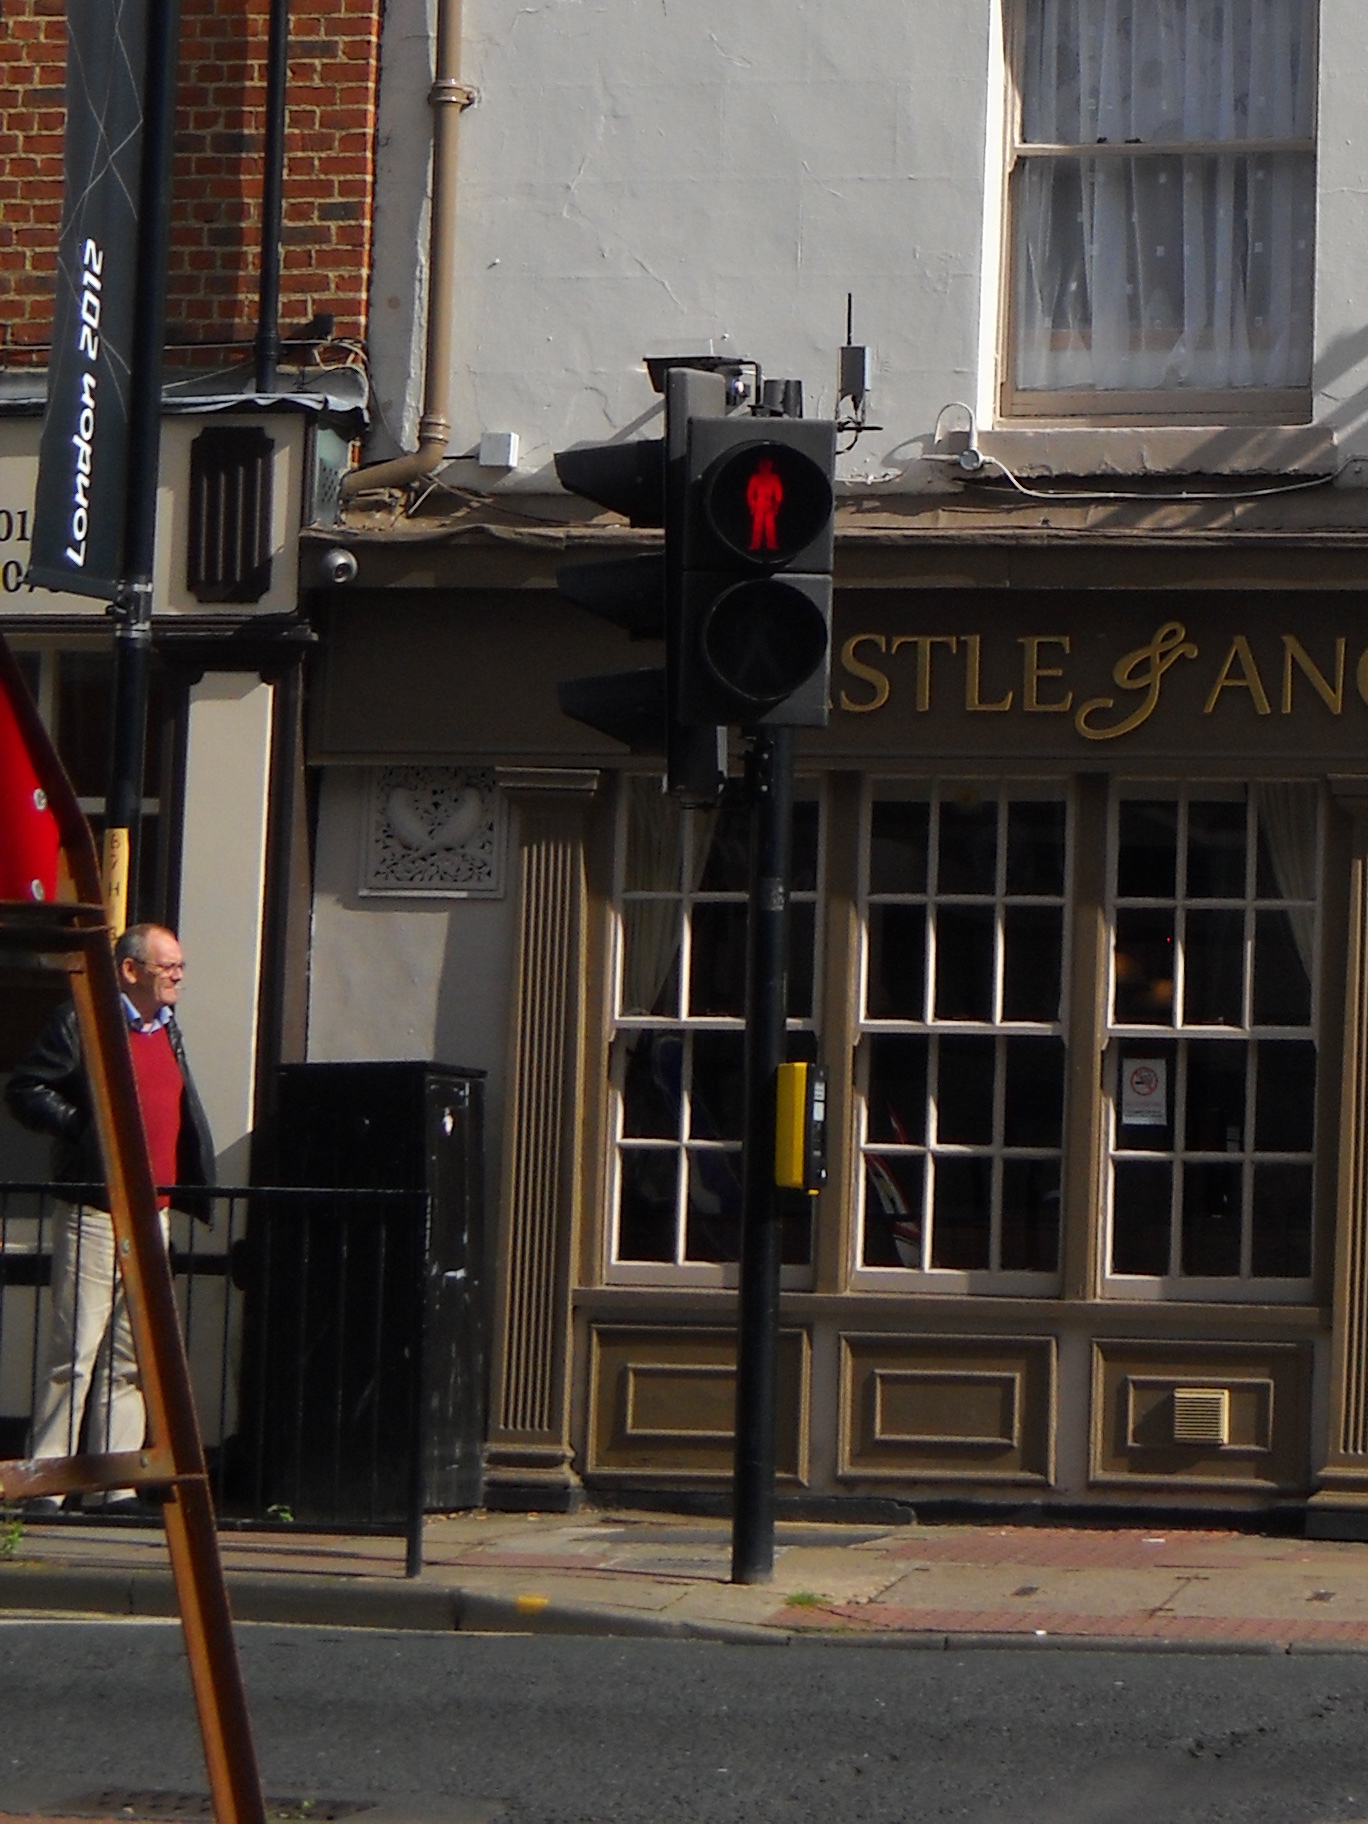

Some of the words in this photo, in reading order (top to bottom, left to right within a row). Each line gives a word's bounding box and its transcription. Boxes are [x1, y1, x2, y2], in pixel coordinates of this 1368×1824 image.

[79, 237, 104, 362] 2012
[65, 372, 97, 567] London
[826, 633, 1073, 713] STLE
[1075, 621, 1198, 740] &
